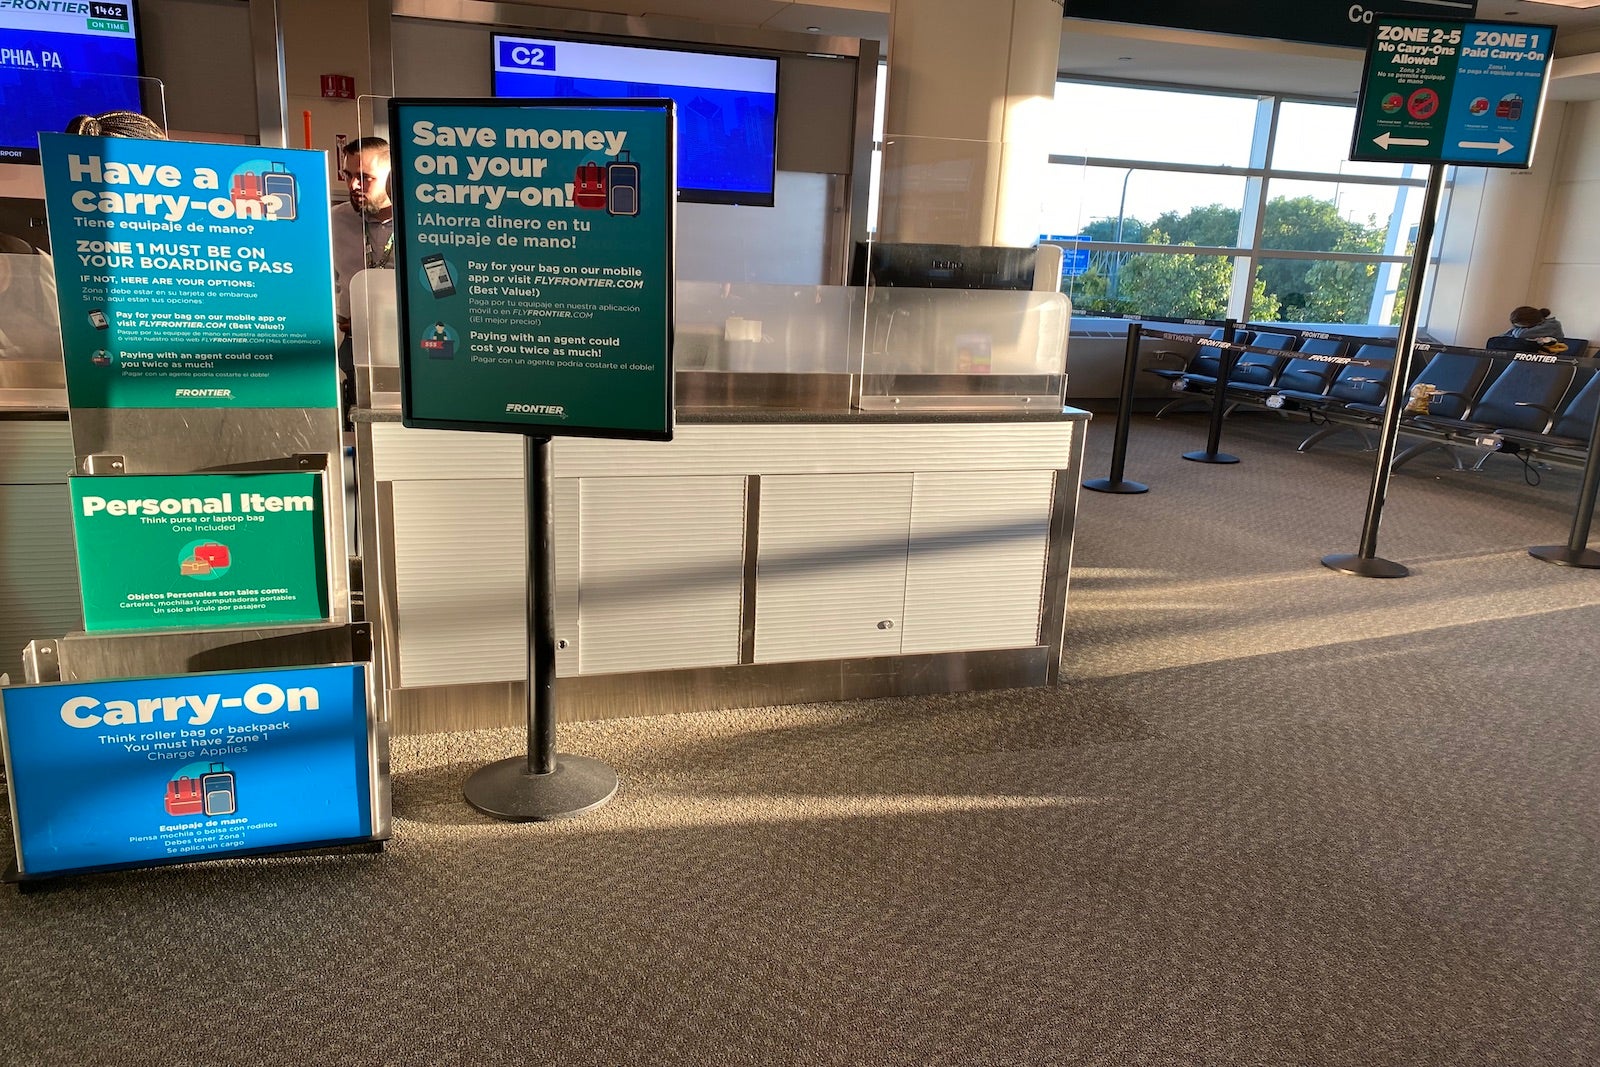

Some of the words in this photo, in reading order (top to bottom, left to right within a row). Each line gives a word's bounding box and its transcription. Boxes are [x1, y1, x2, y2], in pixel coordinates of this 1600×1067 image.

[94, 6, 122, 16] 1462
[106, 22, 124, 30] TIME
[1376, 26, 1430, 42] ZONE
[1431, 29, 1462, 44] 2-5
[1474, 31, 1526, 48] ZONE
[1530, 34, 1539, 48] 1
[511, 46, 545, 66] C2
[1378, 42, 1395, 52] No
[1397, 43, 1456, 56] Carry-Ons
[1462, 47, 1488, 58] Paid
[1490, 49, 1545, 62] Carry-On
[0, 48, 38, 68] PHIA,
[42, 51, 62, 68] PA
[1392, 54, 1439, 66] Allowed
[412, 121, 496, 148] Save
[506, 128, 627, 156] money
[68, 154, 182, 188] Have
[193, 167, 219, 190] a
[414, 154, 458, 175] on
[467, 156, 548, 180] your
[416, 182, 576, 210] carry-on!
[71, 189, 283, 222] carry-on?
[74, 216, 115, 229] Tiene
[120, 219, 182, 233] equipaje
[187, 222, 205, 233] de
[209, 224, 254, 235] mano?
[417, 213, 480, 228] ¡Ahorra
[486, 215, 542, 230] dinero
[547, 220, 568, 230] en
[572, 218, 591, 232] tu
[418, 232, 491, 248] equipaje
[496, 234, 518, 246] de
[523, 236, 576, 248] mano!
[76, 240, 131, 254] ZONE
[136, 242, 144, 254] 1
[150, 243, 201, 257] MUST
[208, 245, 232, 258] BE
[238, 246, 264, 260] ON
[79, 255, 134, 269] YOUR
[141, 257, 242, 273] BOARDING
[248, 260, 294, 274] PASS
[468, 261, 488, 271] Pay
[492, 262, 507, 270] for
[510, 264, 536, 274] your
[538, 263, 560, 274] bag
[563, 266, 578, 274] on
[603, 266, 642, 276] mobile
[93, 276, 118, 284] NOT,
[121, 276, 148, 284] HERE
[152, 277, 173, 285] ARE
[176, 278, 204, 286] YOUR
[208, 279, 256, 288] OPTIONS:
[468, 274, 489, 284] app
[508, 274, 532, 284] visit
[534, 276, 644, 288] FLYFRONTIER.COM
[469, 286, 498, 296] (Best
[502, 287, 540, 298] Value!)
[116, 312, 132, 320] Pay
[174, 312, 192, 320] bag
[226, 314, 256, 322] mobile
[138, 321, 226, 329] FLYFRONTIER.COM
[228, 322, 252, 330] (Best
[470, 331, 507, 342] Paying
[510, 332, 534, 342] with
[538, 335, 550, 343] an
[554, 336, 586, 346] agent
[589, 336, 620, 346] could
[1197, 338, 1232, 350] FRONTIER
[120, 351, 154, 360] Paying
[470, 344, 493, 352] cost
[496, 345, 516, 354] you
[520, 345, 550, 354] twice
[553, 348, 566, 356] as
[568, 346, 602, 358] much!
[1514, 353, 1558, 364] FRONTIER
[1308, 354, 1352, 364] FRONTIER
[176, 388, 231, 396] FRONTIER
[506, 404, 564, 414] FRONTIER
[82, 493, 232, 517] Personal
[240, 493, 314, 513] Item
[140, 516, 167, 524] Think
[170, 516, 198, 524] purse
[213, 514, 244, 524] laptop
[246, 514, 264, 522] bag
[172, 525, 192, 533] One
[195, 524, 236, 532] Included
[127, 592, 164, 601] Objetos
[166, 591, 216, 599] Personales
[202, 596, 258, 604] computadoras
[260, 594, 296, 602] portables
[60, 683, 320, 728] Carry-On
[99, 733, 136, 744] Think
[140, 730, 177, 742] roller
[180, 728, 206, 740] bag
[210, 726, 224, 736] or
[228, 722, 290, 735] backpack
[124, 743, 150, 752] You
[154, 740, 187, 750] must
[191, 736, 222, 747] have
[226, 734, 259, 744] Zone
[264, 733, 268, 742] 1
[148, 749, 195, 760] Charge
[200, 744, 248, 757] Applies
[160, 822, 204, 832] Equipaje
[160, 830, 194, 839] mochila
[246, 822, 278, 830] rodillos
[180, 844, 205, 852] aplica
[220, 840, 244, 848] cargo
